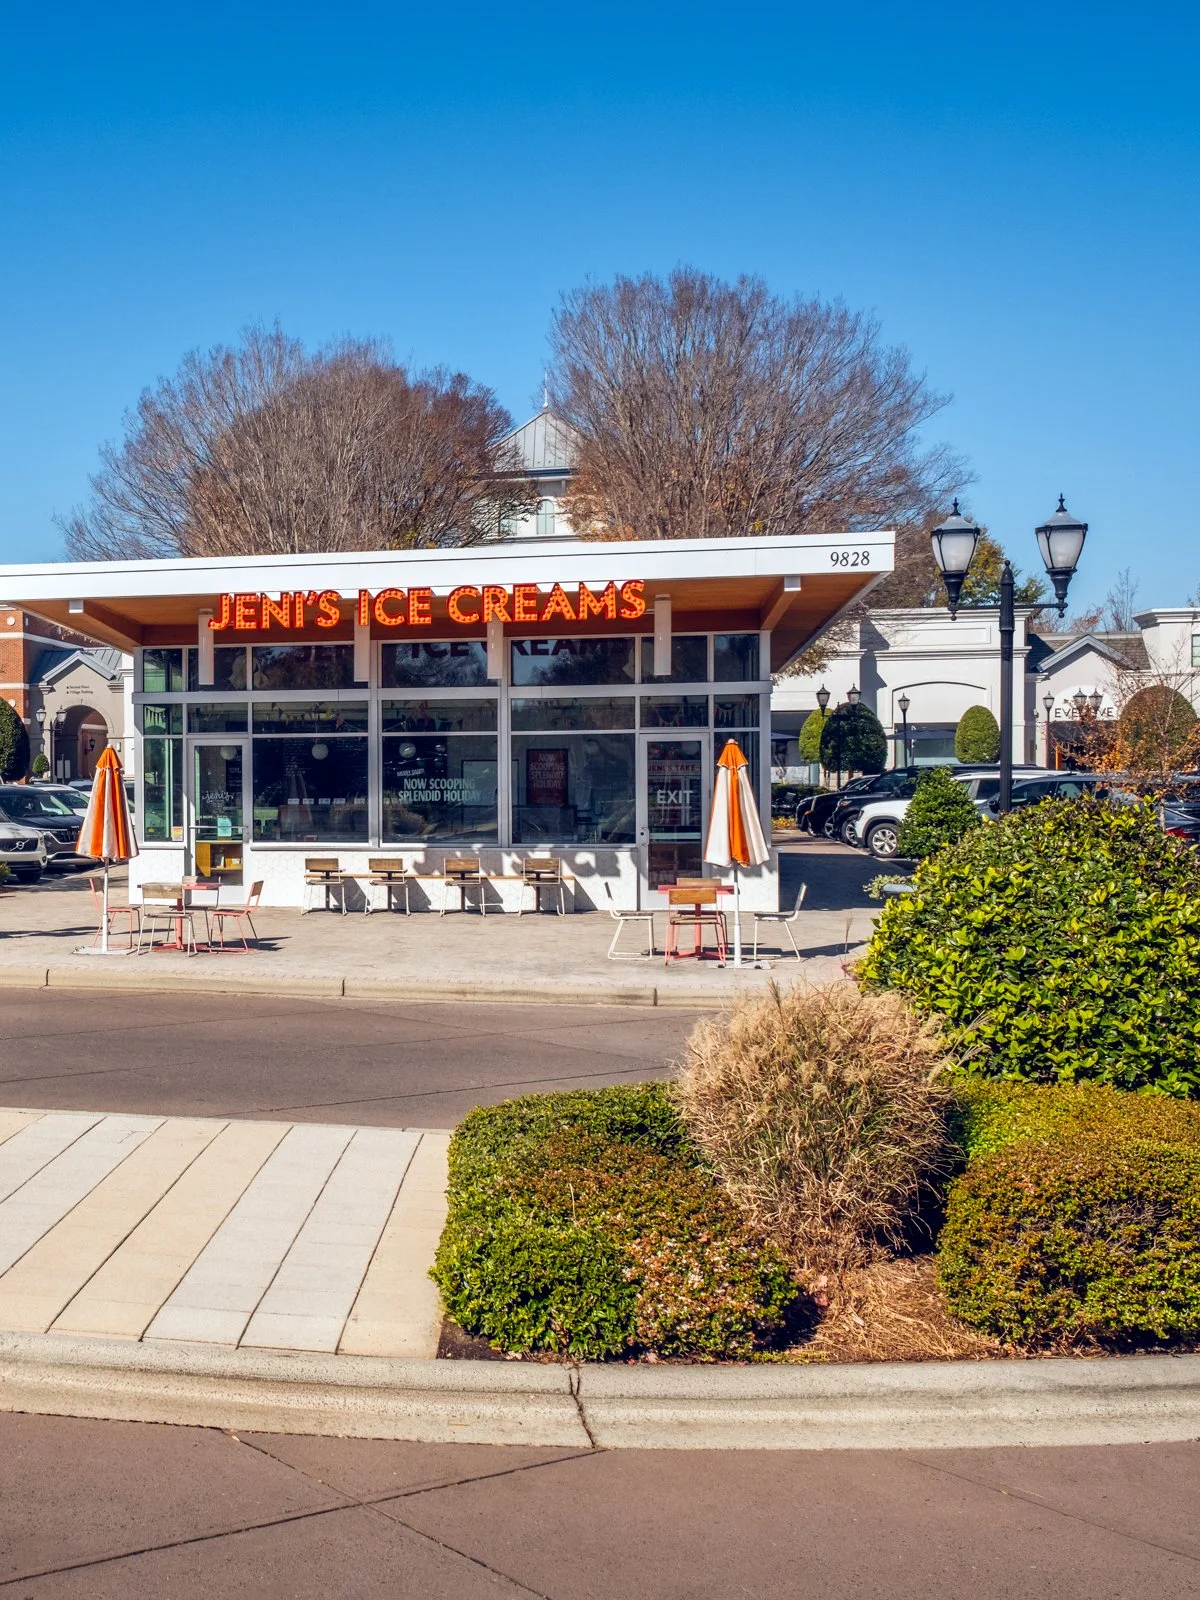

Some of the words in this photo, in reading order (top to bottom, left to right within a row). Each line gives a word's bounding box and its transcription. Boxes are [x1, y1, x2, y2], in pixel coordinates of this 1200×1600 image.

[830, 550, 870, 567] 9828
[208, 589, 341, 631] JENI'S
[358, 587, 432, 626] ICE
[447, 579, 646, 624] CREAMS
[1055, 707, 1114, 718] EVEVE
[404, 778, 427, 790] NOW
[430, 778, 475, 790] SCOOPING
[398, 790, 441, 802] SPLENDID
[443, 790, 481, 802] HOLIDAY
[657, 789, 694, 804] EXIT
